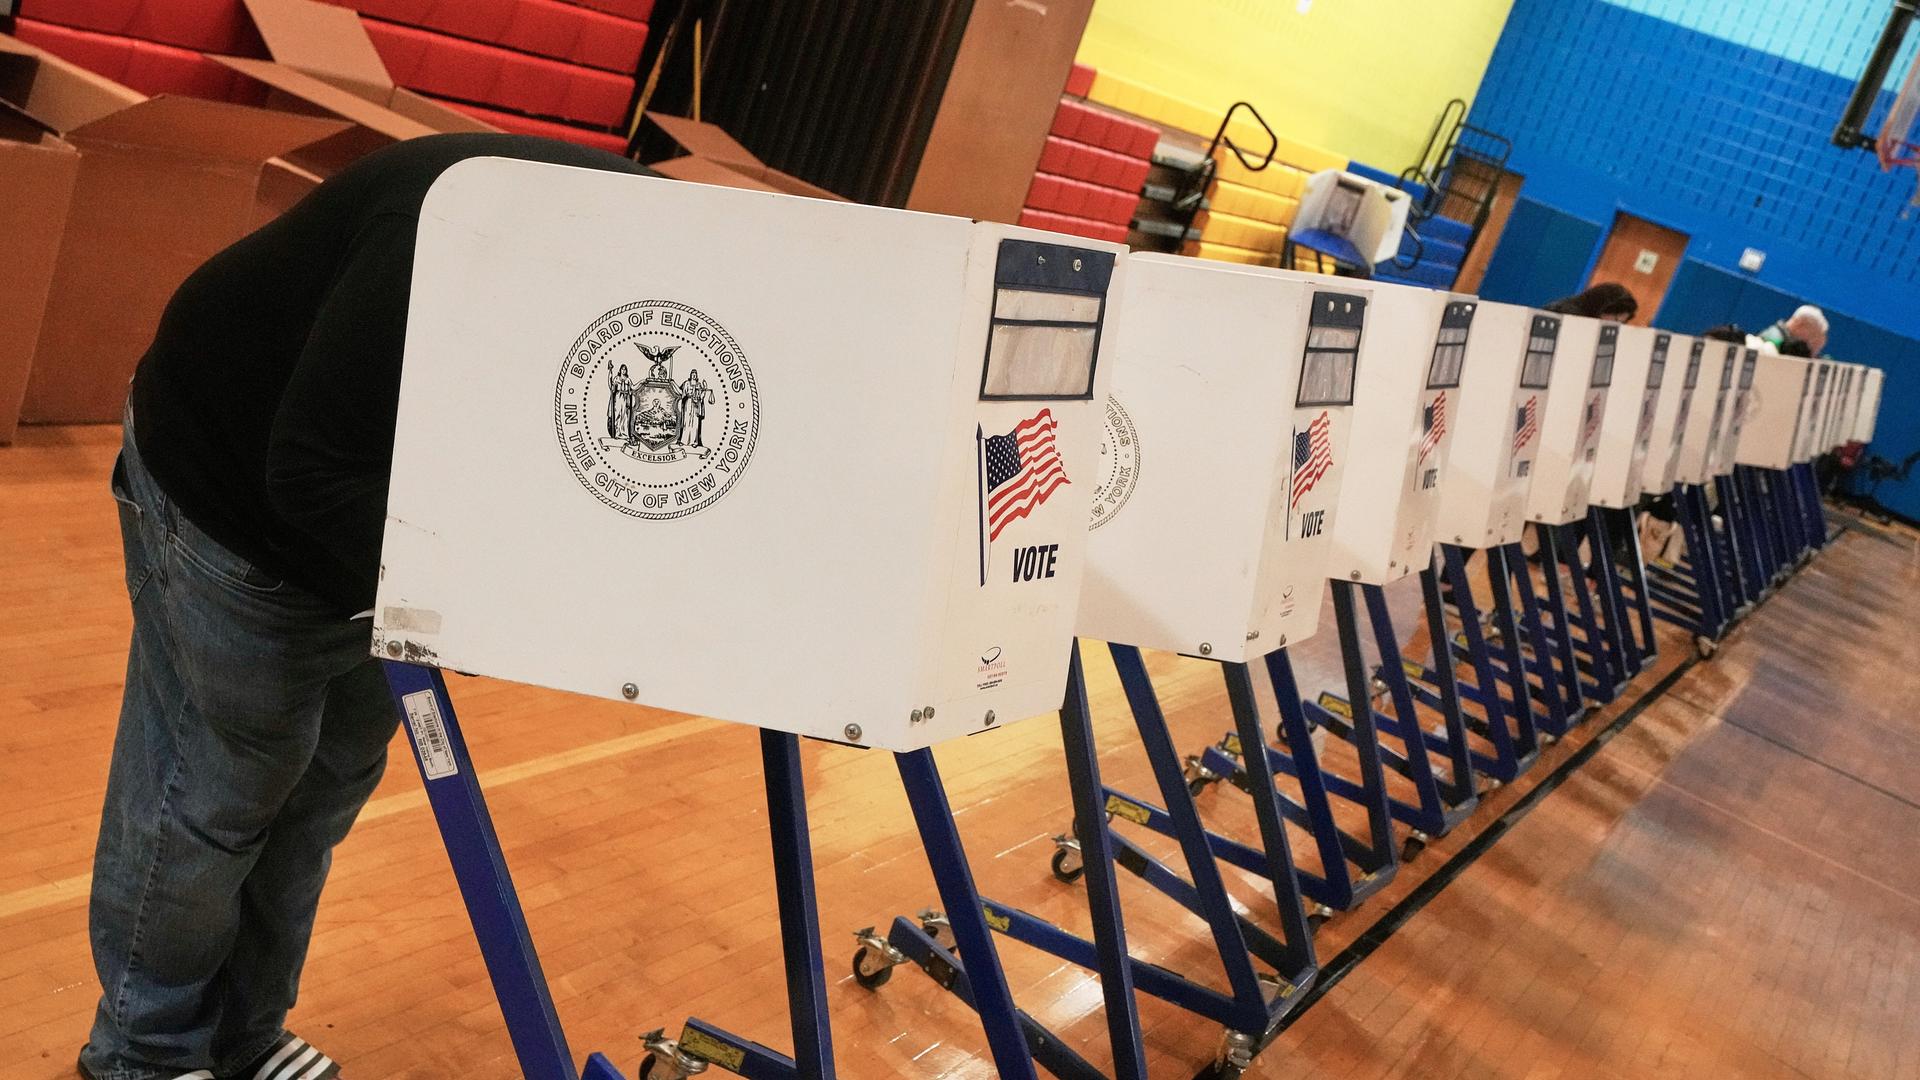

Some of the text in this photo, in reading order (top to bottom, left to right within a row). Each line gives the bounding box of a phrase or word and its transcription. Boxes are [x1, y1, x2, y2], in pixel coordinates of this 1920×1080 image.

[570, 310, 746, 393] BOARD OF ELECTIONS
[1105, 404, 1130, 447] TIONS
[564, 404, 748, 509] IN THE CITY OF NEW YORK
[631, 450, 677, 462] EXCELSIOR
[1104, 466, 1131, 505] YORK
[1422, 468, 1438, 490] VOTE
[1301, 510, 1325, 539] VOTE
[1013, 544, 1059, 582] VOTE
